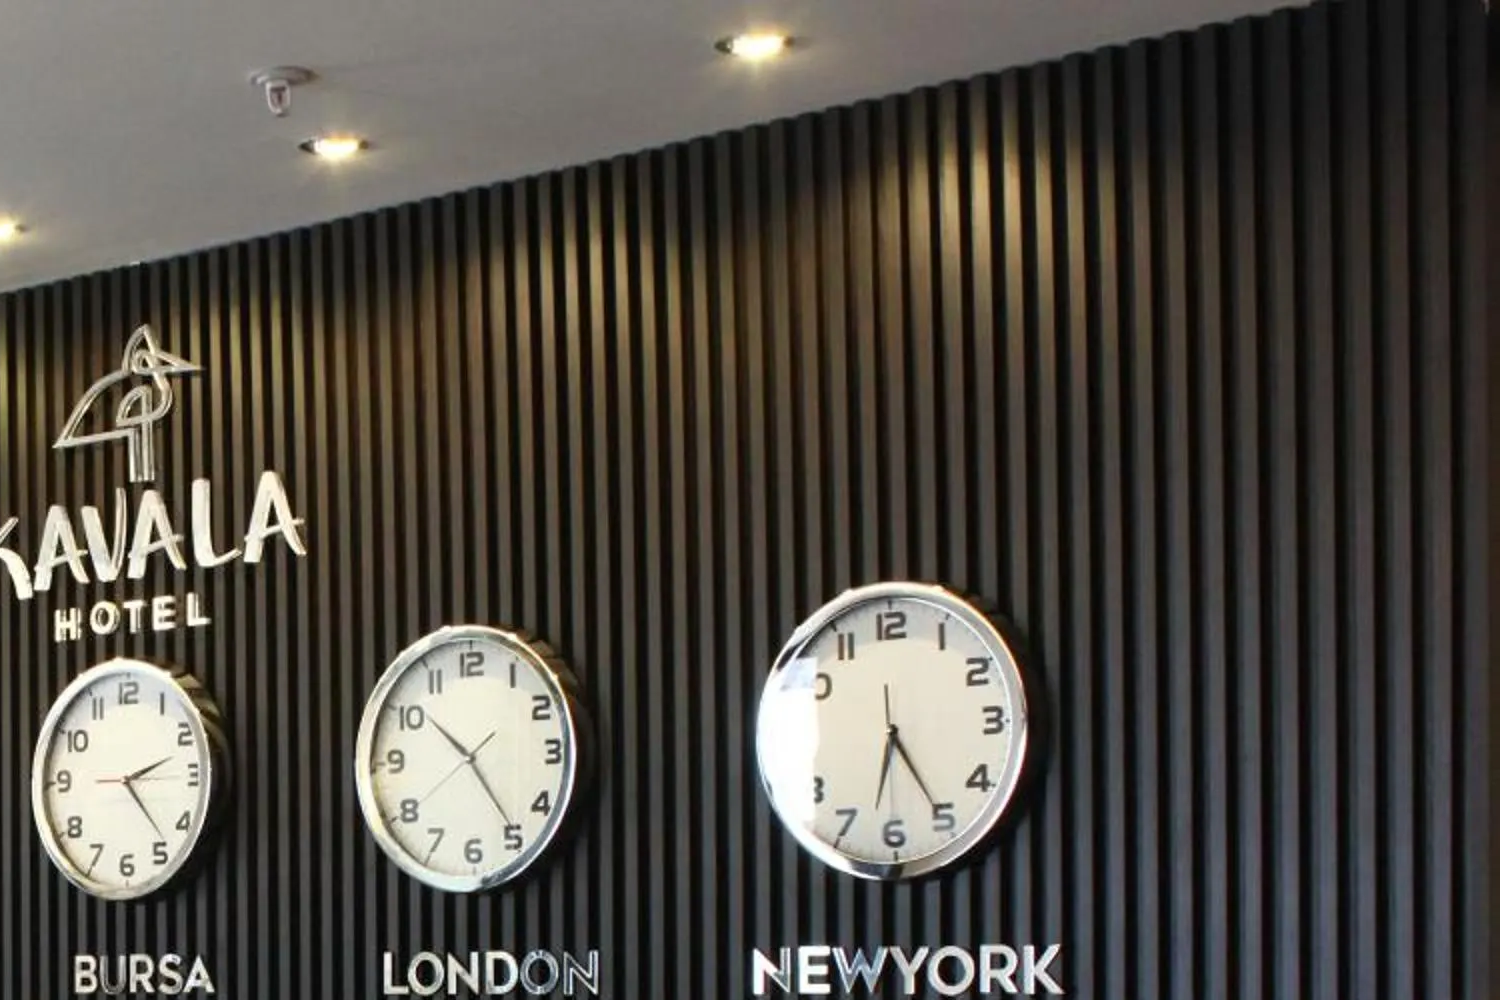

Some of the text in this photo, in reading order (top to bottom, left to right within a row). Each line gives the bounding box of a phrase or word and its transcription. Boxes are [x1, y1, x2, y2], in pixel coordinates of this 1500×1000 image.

[54, 592, 211, 642] HOTEL
[876, 612, 907, 641] 12
[838, 632, 855, 661] 11
[938, 622, 945, 651] 1
[459, 652, 484, 678] 12
[509, 663, 516, 689] 1
[965, 657, 989, 686] 2
[118, 682, 140, 705] 12
[429, 669, 442, 694] 11
[91, 696, 104, 720] 11
[159, 692, 165, 716] 1
[532, 695, 551, 721] 2
[399, 705, 425, 731] 10
[982, 705, 1003, 735] 3
[67, 729, 89, 753] 10
[177, 722, 193, 746] 2
[387, 749, 405, 774] 9
[544, 738, 561, 765] 3
[57, 770, 72, 793] 9
[187, 763, 199, 787] 3
[965, 763, 991, 792] 4
[400, 798, 419, 823] 8
[531, 790, 550, 817] 4
[67, 815, 83, 839] 8
[175, 811, 191, 832] 4
[835, 808, 857, 836] 7
[932, 802, 955, 832] 5
[427, 827, 445, 853] 7
[503, 824, 523, 850] 5
[882, 820, 906, 848] 6
[89, 843, 105, 866] 7
[152, 842, 168, 865] 5
[464, 838, 483, 864] 6
[119, 853, 135, 877] 6
[73, 954, 215, 994] BURSA
[382, 950, 599, 996] LONDON
